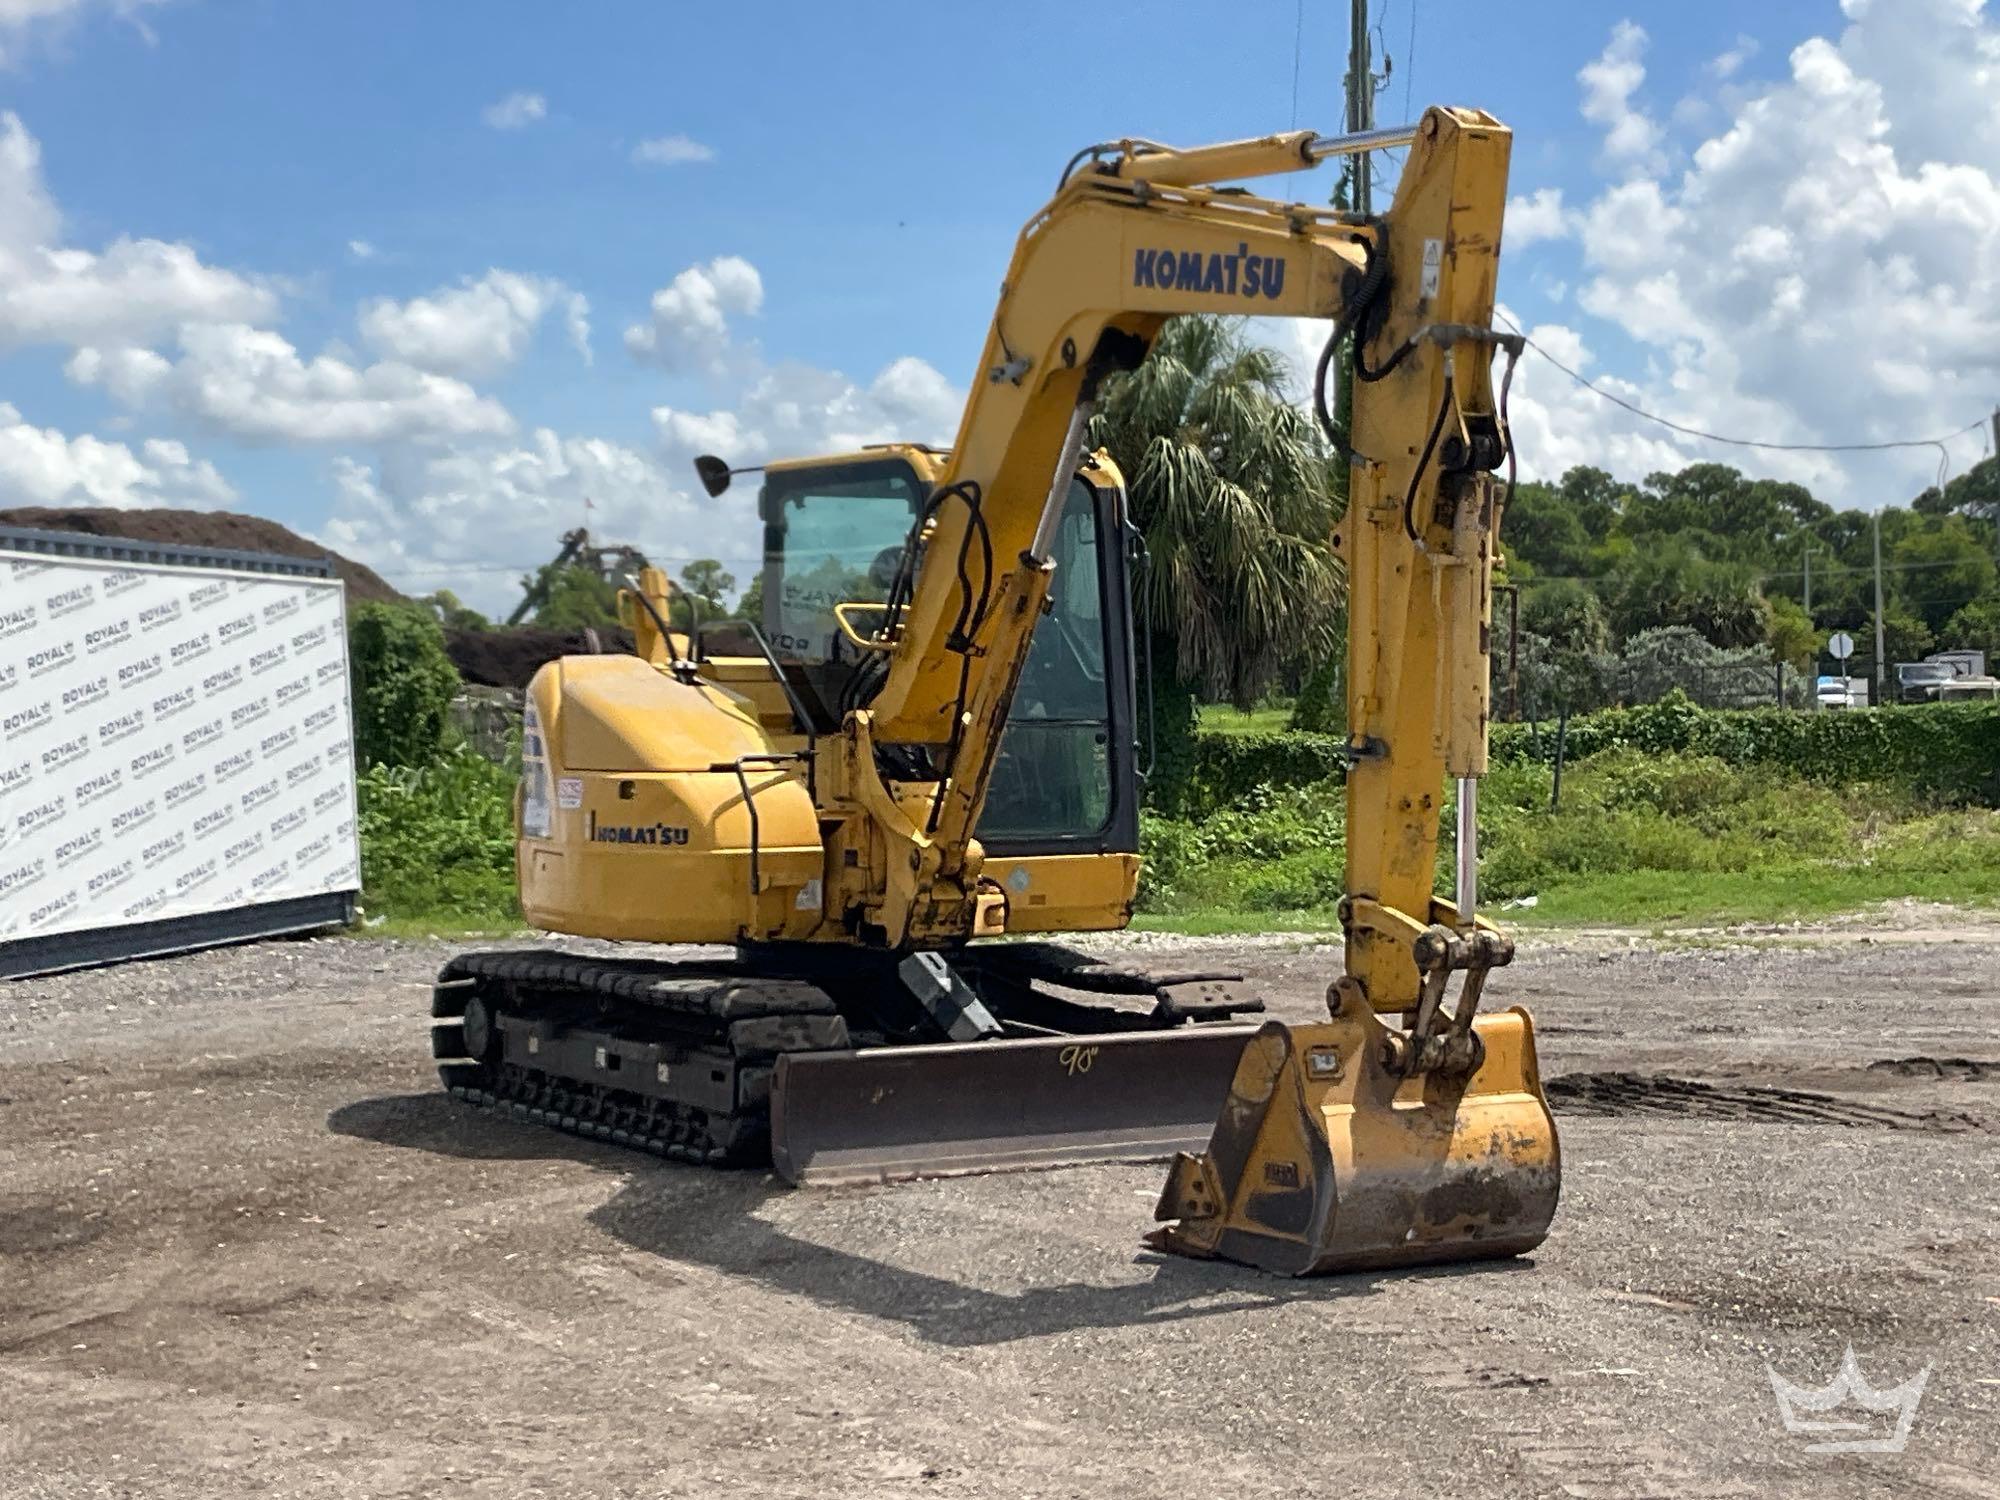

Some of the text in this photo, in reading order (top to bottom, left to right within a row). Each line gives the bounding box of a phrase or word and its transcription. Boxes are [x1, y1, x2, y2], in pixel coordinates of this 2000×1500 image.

[1134, 243, 1286, 300] KOMATSU
[47, 588, 83, 609] ROYAL
[0, 611, 26, 630] OYAL
[139, 605, 172, 624] ROYAL
[85, 624, 121, 645] ROYAL
[218, 618, 249, 637] ROYAL
[27, 646, 65, 669] ROYAL
[171, 637, 202, 657] ROYAL
[250, 649, 278, 668] ROYAL
[118, 661, 153, 681] ROYAL
[203, 670, 234, 690] ROYAL
[62, 681, 98, 704] ROYAL
[276, 680, 303, 698] ROYAL
[153, 691, 186, 713] ROYAL
[231, 702, 260, 721] ROYAL
[4, 706, 41, 731] ROYAL
[100, 715, 135, 737] ROYAL
[183, 724, 214, 745] ROYAL
[261, 731, 289, 750] ROYAL
[42, 741, 79, 765] ROYAL
[131, 748, 165, 771] ROYAL
[0, 768, 22, 784] YAL
[214, 755, 245, 775] ROYAL
[76, 774, 112, 799] ROYAL
[165, 777, 197, 801] ROYAL
[242, 786, 271, 806] ROYAL
[18, 802, 56, 828] ROYAL
[112, 806, 146, 828] ROYAL
[193, 809, 225, 831] ROYAL
[56, 834, 92, 859] ROYAL
[142, 837, 176, 860] ROYAL
[224, 839, 255, 859] ROYAL
[88, 866, 123, 890] ROYAL
[176, 864, 208, 888] ROYAL
[30, 896, 68, 924] ROYAL
[124, 893, 159, 918] ROYAL
